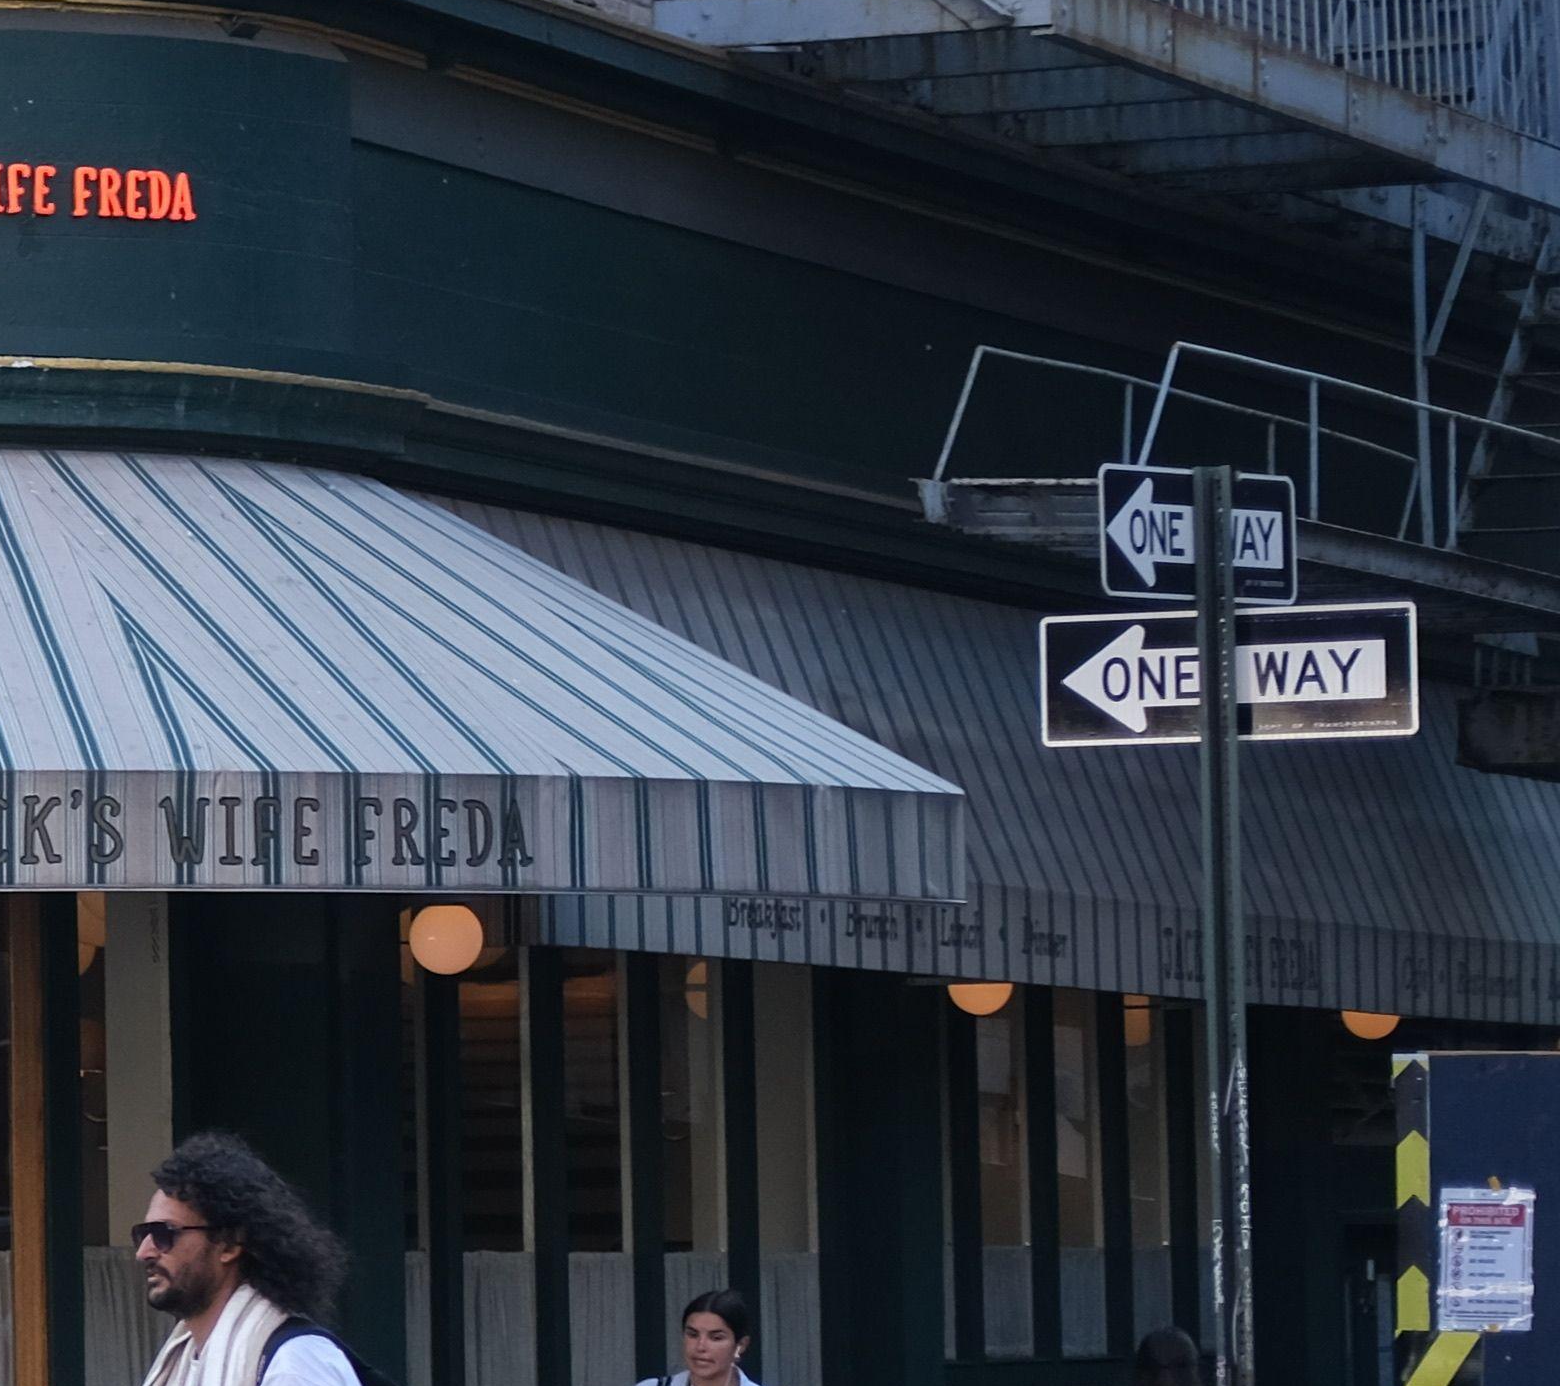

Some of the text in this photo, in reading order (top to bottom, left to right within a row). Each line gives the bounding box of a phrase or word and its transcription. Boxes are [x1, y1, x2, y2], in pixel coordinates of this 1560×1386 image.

[72, 166, 198, 222] FREDA
[1129, 508, 1185, 557] ONE
[1102, 647, 1363, 702] ONE WAY
[158, 795, 321, 869] WIFE
[353, 796, 535, 870] FREDA
